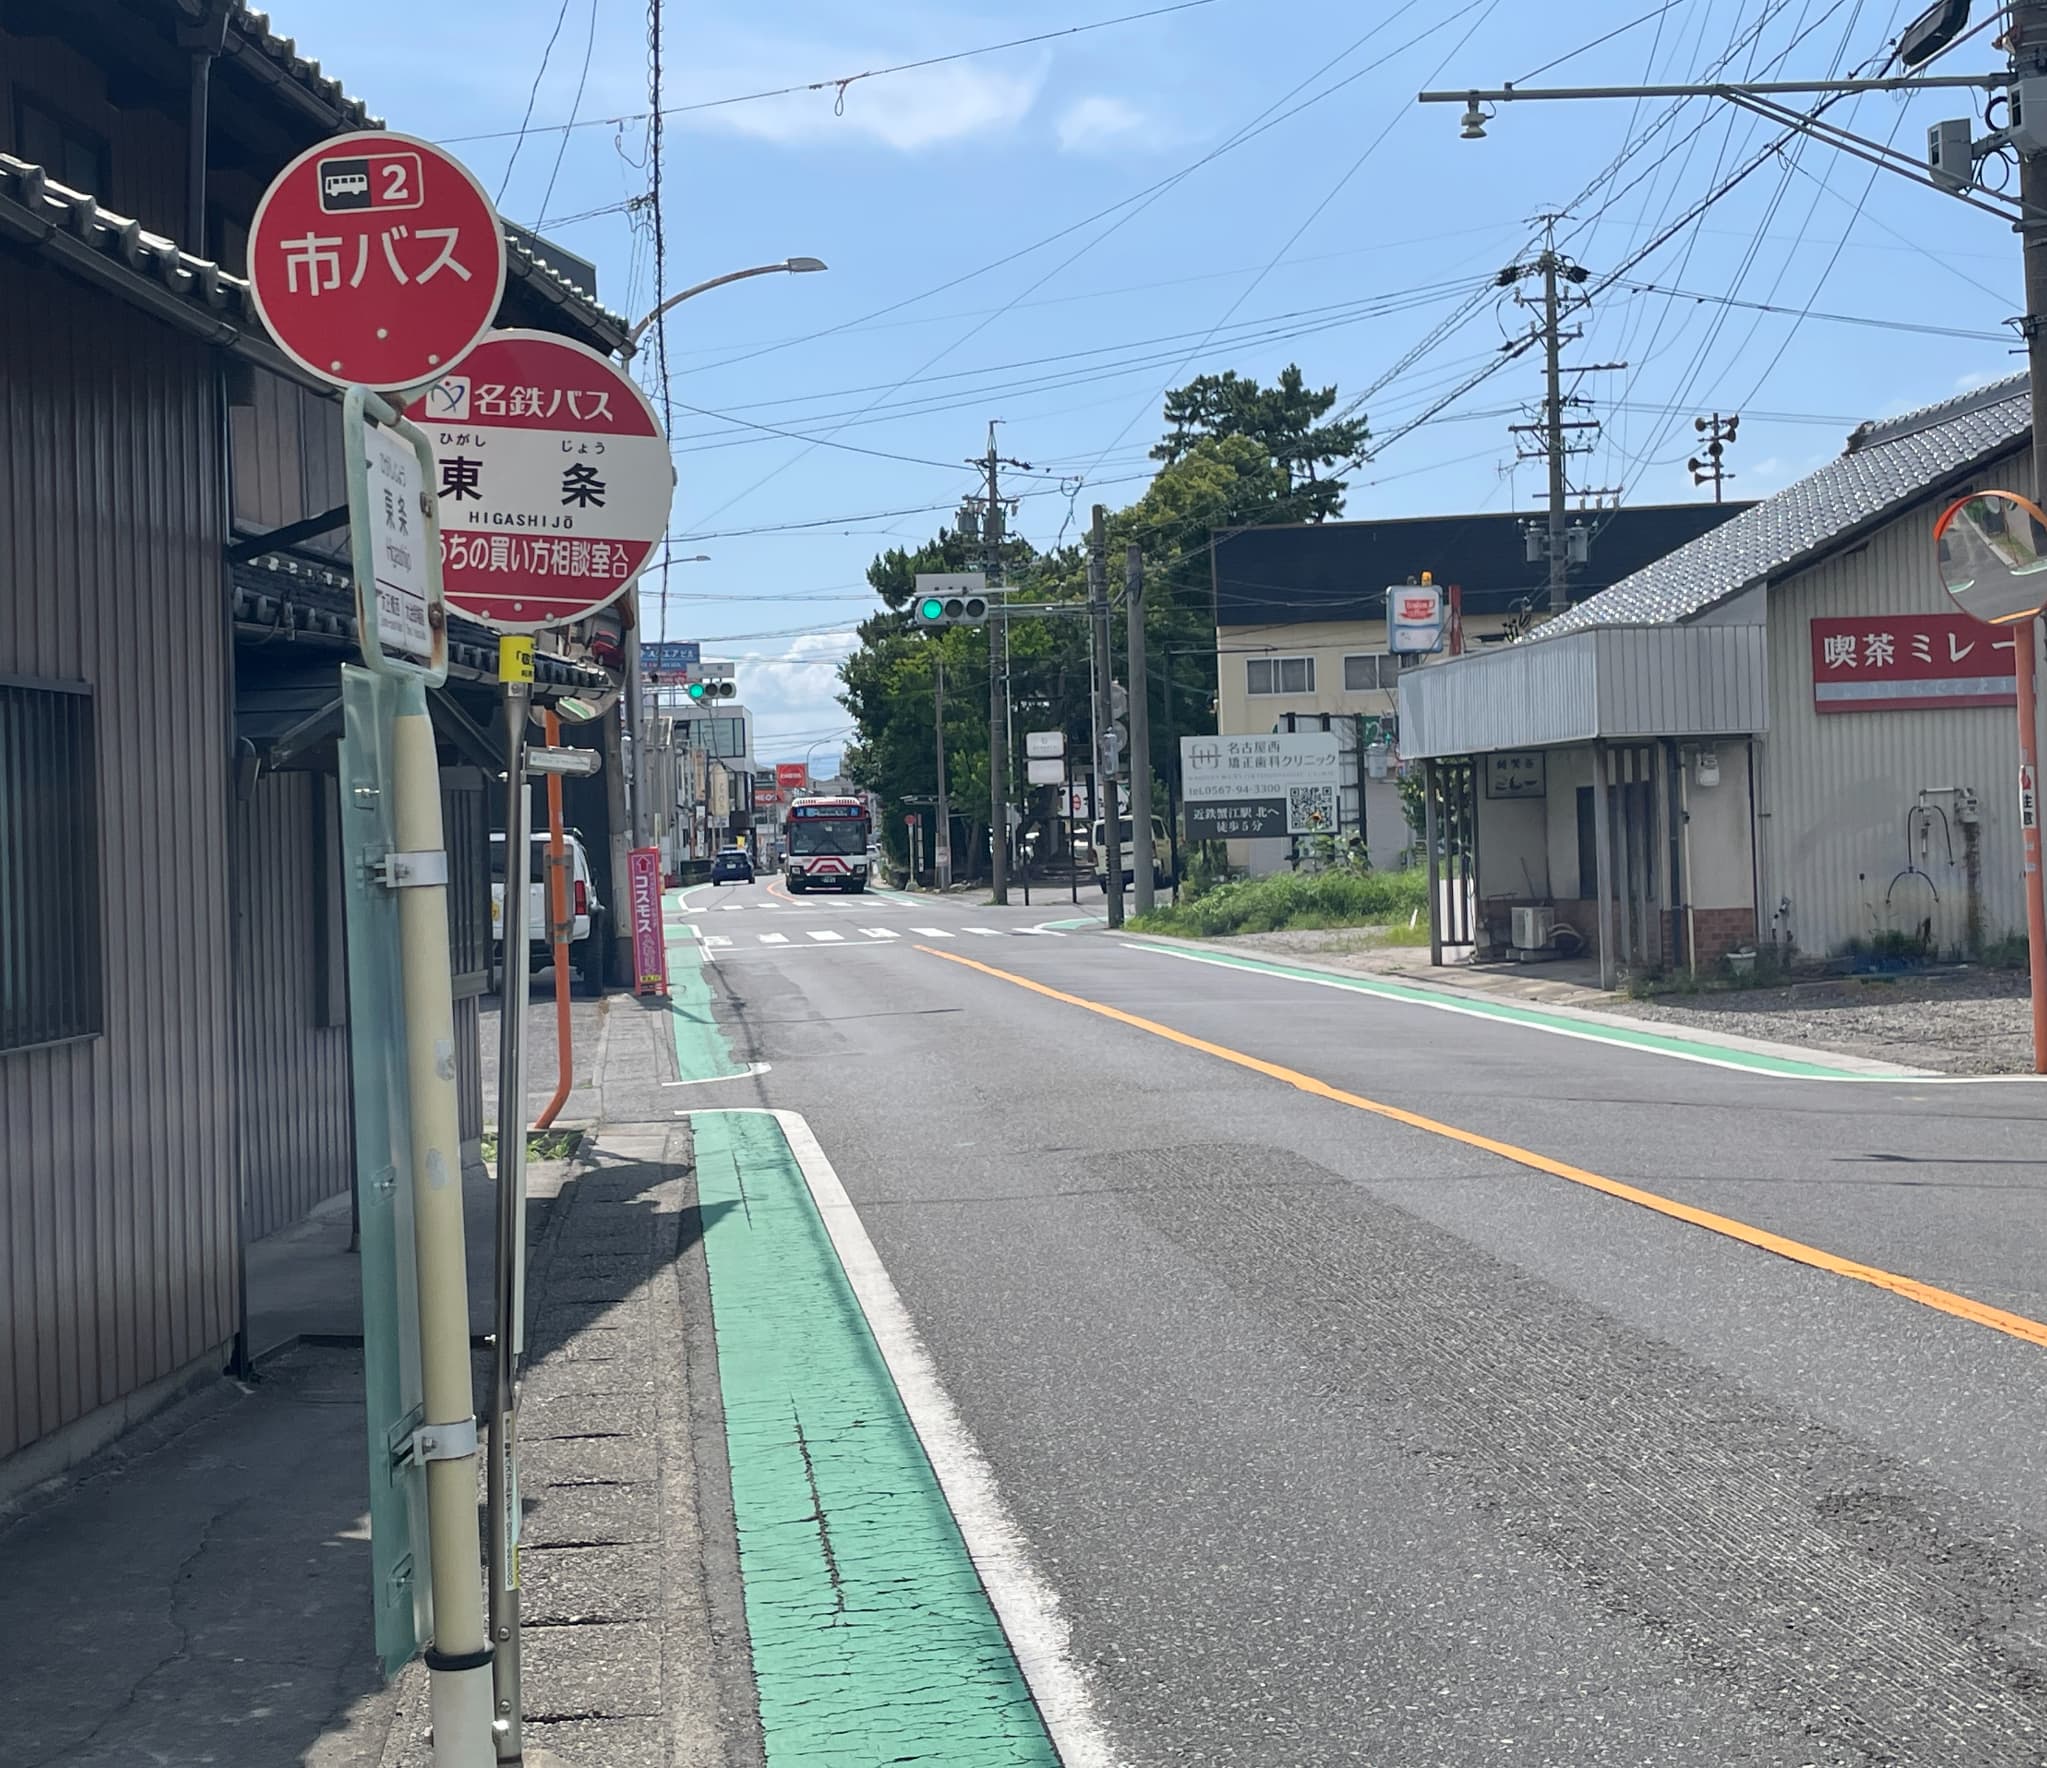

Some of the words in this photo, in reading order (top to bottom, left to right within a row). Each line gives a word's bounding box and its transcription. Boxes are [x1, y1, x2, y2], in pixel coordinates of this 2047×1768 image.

[382, 164, 409, 200] 2
[280, 225, 472, 296] 市バス
[474, 384, 613, 421] 名鉄バス
[440, 433, 486, 447] ひがし
[562, 440, 605, 455] じょう
[437, 456, 483, 501] 東
[561, 462, 606, 508] 条
[1824, 632, 2015, 669] 喫茶ミレー
[1227, 741, 1280, 755] 名古屋西
[1228, 753, 1336, 769] 矯正歯科クリニック
[1256, 806, 1280, 819] 北へ
[636, 875, 651, 933] コスモス
